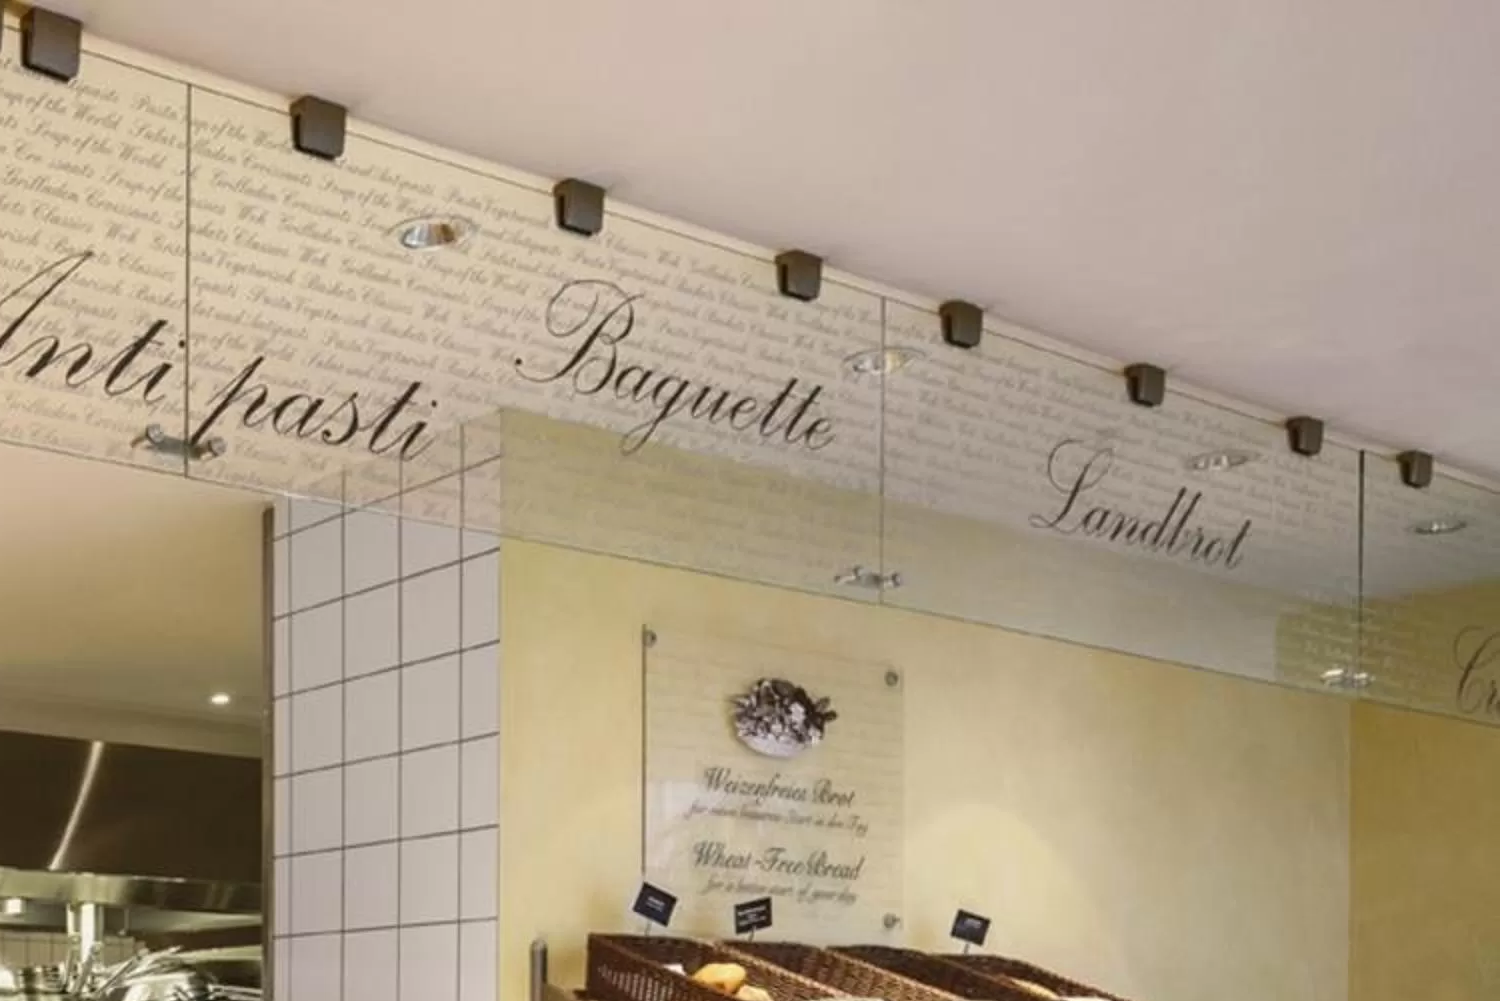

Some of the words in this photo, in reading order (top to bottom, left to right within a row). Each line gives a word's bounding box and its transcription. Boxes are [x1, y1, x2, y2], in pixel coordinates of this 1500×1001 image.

[514, 278, 837, 457] Baguette
[1028, 438, 1252, 570] Landbrot
[812, 778, 856, 808] Brot
[806, 850, 866, 881] Bread
